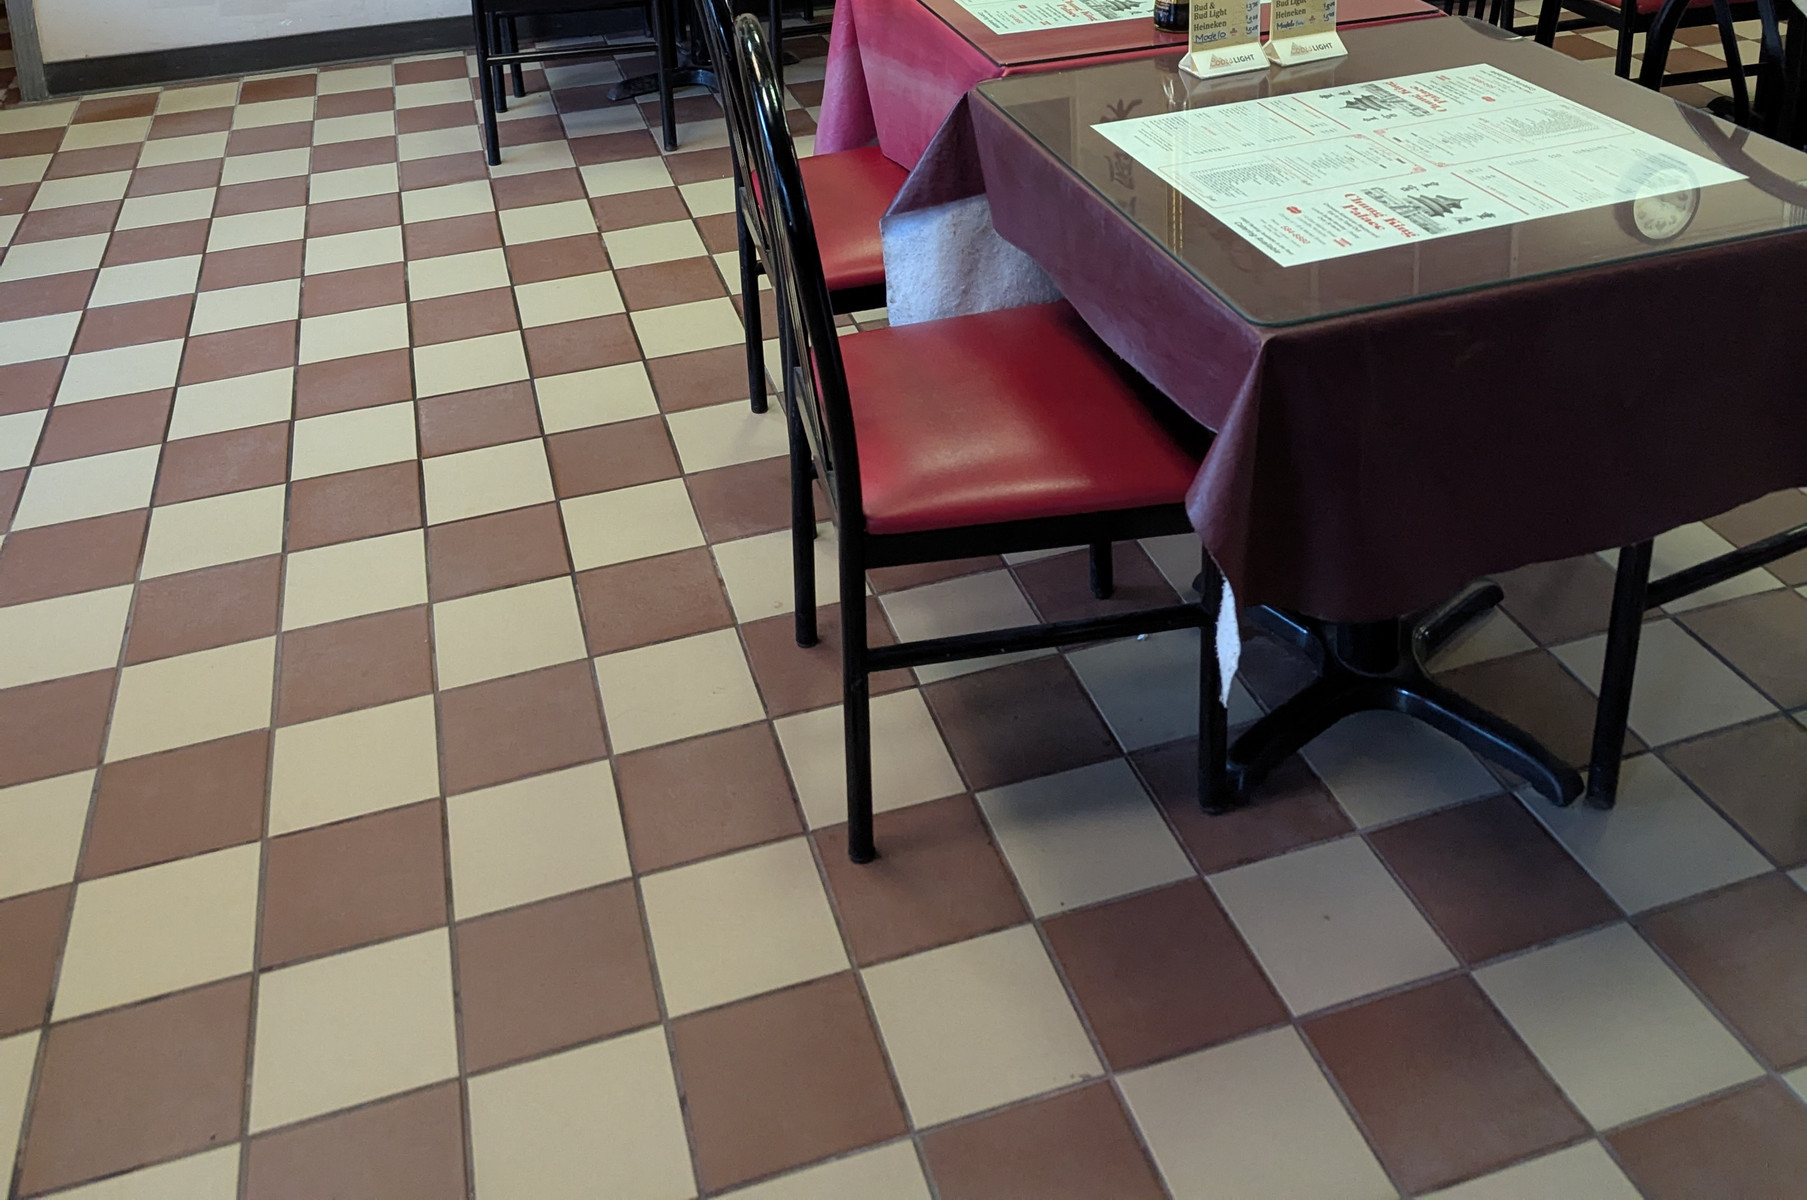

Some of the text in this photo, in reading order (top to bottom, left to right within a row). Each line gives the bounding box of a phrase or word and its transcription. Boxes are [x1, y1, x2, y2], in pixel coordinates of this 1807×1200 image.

[1194, 3, 1208, 12] Bud
[1276, 0, 1289, 8] Bud
[1194, 11, 1208, 20] Bud
[1209, 8, 1227, 18] Light
[1276, 8, 1307, 19] Heineken
[1194, 20, 1227, 31] Heineken
[1312, 43, 1333, 51] LIGHT
[1233, 54, 1255, 63] LIGHT
[1342, 203, 1385, 231] Palace
[1344, 193, 1420, 238] Chung King
